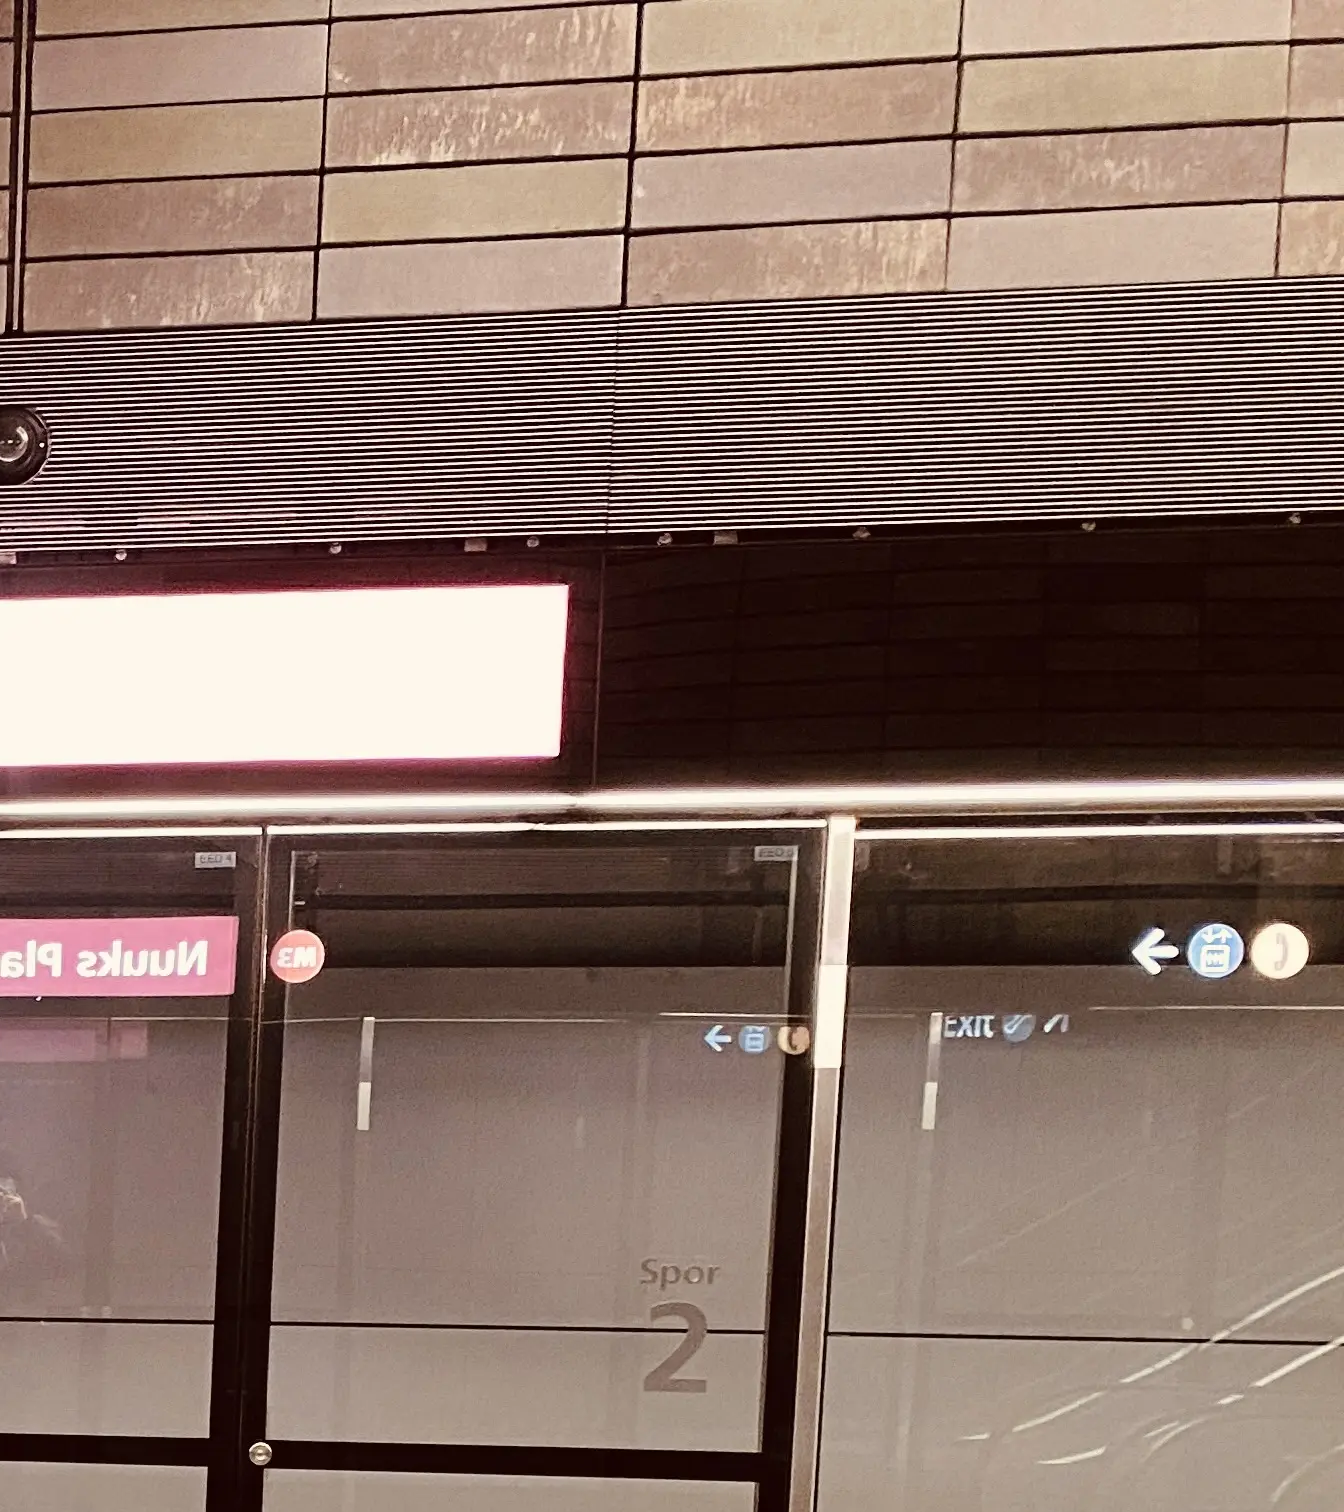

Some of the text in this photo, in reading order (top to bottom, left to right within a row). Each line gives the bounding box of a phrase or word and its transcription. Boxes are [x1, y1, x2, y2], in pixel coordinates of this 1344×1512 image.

[943, 1014, 995, 1038] EXIT
[640, 1258, 720, 1291] Spor
[643, 1302, 708, 1393] 2
